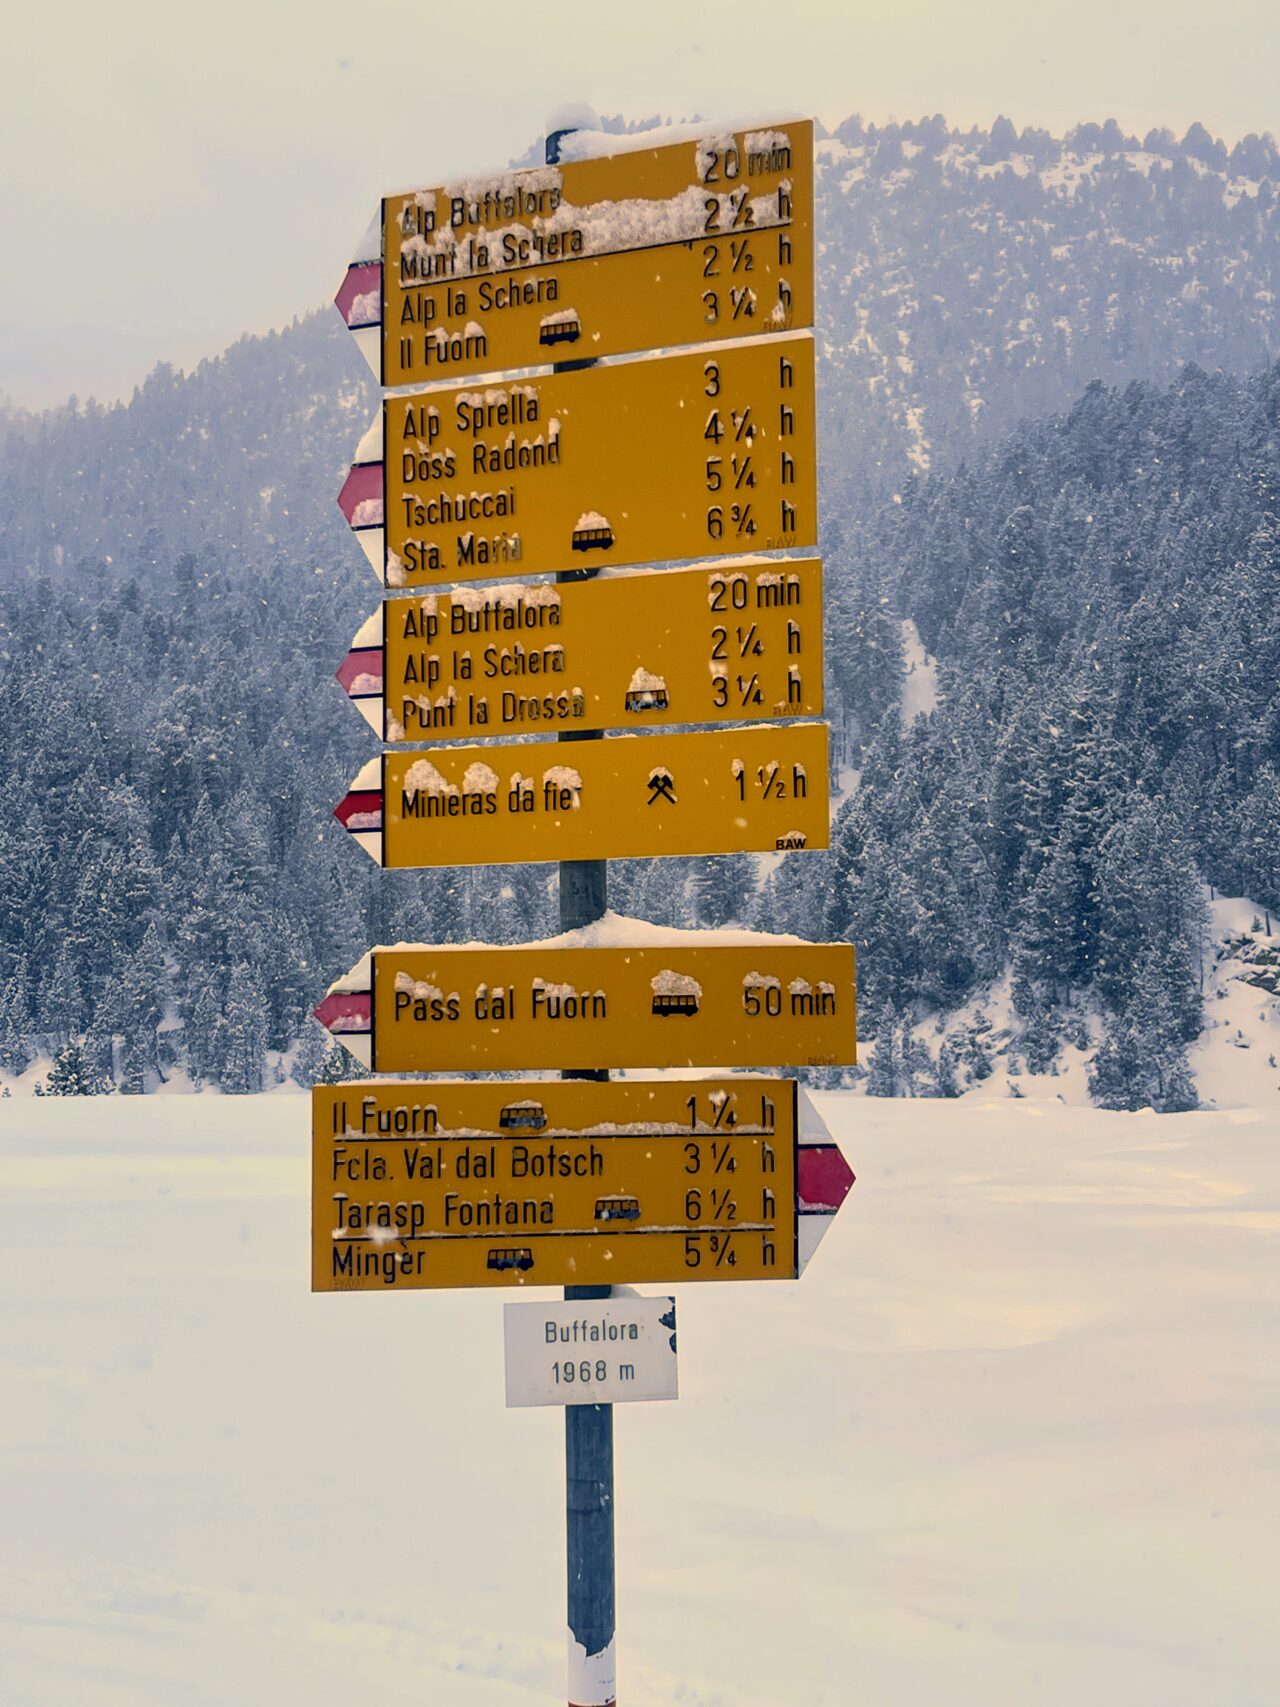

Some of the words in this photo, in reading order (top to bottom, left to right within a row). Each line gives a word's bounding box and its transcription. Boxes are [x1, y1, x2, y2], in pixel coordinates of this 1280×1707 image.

[703, 149, 739, 184] 20
[469, 240, 489, 270] la
[502, 228, 583, 264] Schera
[778, 186, 791, 219] h
[400, 293, 436, 328] Alp
[447, 287, 466, 317] la
[478, 277, 559, 312] Schera
[779, 234, 791, 266] h
[425, 334, 487, 366] Fuorn
[403, 408, 440, 445] Alp
[456, 394, 538, 437] Sprella
[704, 366, 720, 397] 3
[780, 356, 793, 388] h
[473, 433, 560, 475] Radond
[781, 404, 793, 436] h
[402, 487, 515, 528] Tschuccai
[781, 452, 794, 484] h
[403, 541, 447, 572] Sta.
[782, 500, 795, 532] h
[403, 608, 438, 645] Alp
[451, 598, 561, 635] Buffalora
[711, 578, 747, 612] 20
[757, 575, 800, 608] min
[403, 653, 440, 689] Alp
[453, 651, 472, 680] la
[484, 645, 564, 678] Schera
[788, 622, 801, 654] h
[403, 696, 455, 730] Punt
[469, 695, 488, 725] la
[502, 692, 585, 723] Drossa
[788, 671, 801, 704] h
[402, 788, 497, 819] Minieras
[508, 782, 534, 812] da
[793, 766, 806, 798] h
[776, 838, 807, 851] BAW
[395, 991, 460, 1022] Pass
[532, 988, 607, 1019] Fuorn
[744, 986, 782, 1016] 50
[792, 986, 836, 1016] min
[333, 1102, 347, 1133] Il
[362, 1101, 438, 1133] Fuorn
[762, 1095, 775, 1128] h
[333, 1148, 394, 1181] Fcla.
[404, 1146, 442, 1179] Val
[456, 1146, 495, 1179] dal
[511, 1145, 604, 1178] Botsch
[761, 1141, 775, 1173] h
[333, 1196, 425, 1238] Tarasp
[445, 1194, 554, 1227] Fontana
[763, 1188, 775, 1219] h
[332, 1240, 425, 1284] Mingèr
[762, 1234, 775, 1266] h
[545, 1319, 639, 1344] Buffalora
[552, 1360, 607, 1384] 1968
[619, 1364, 635, 1381] m
